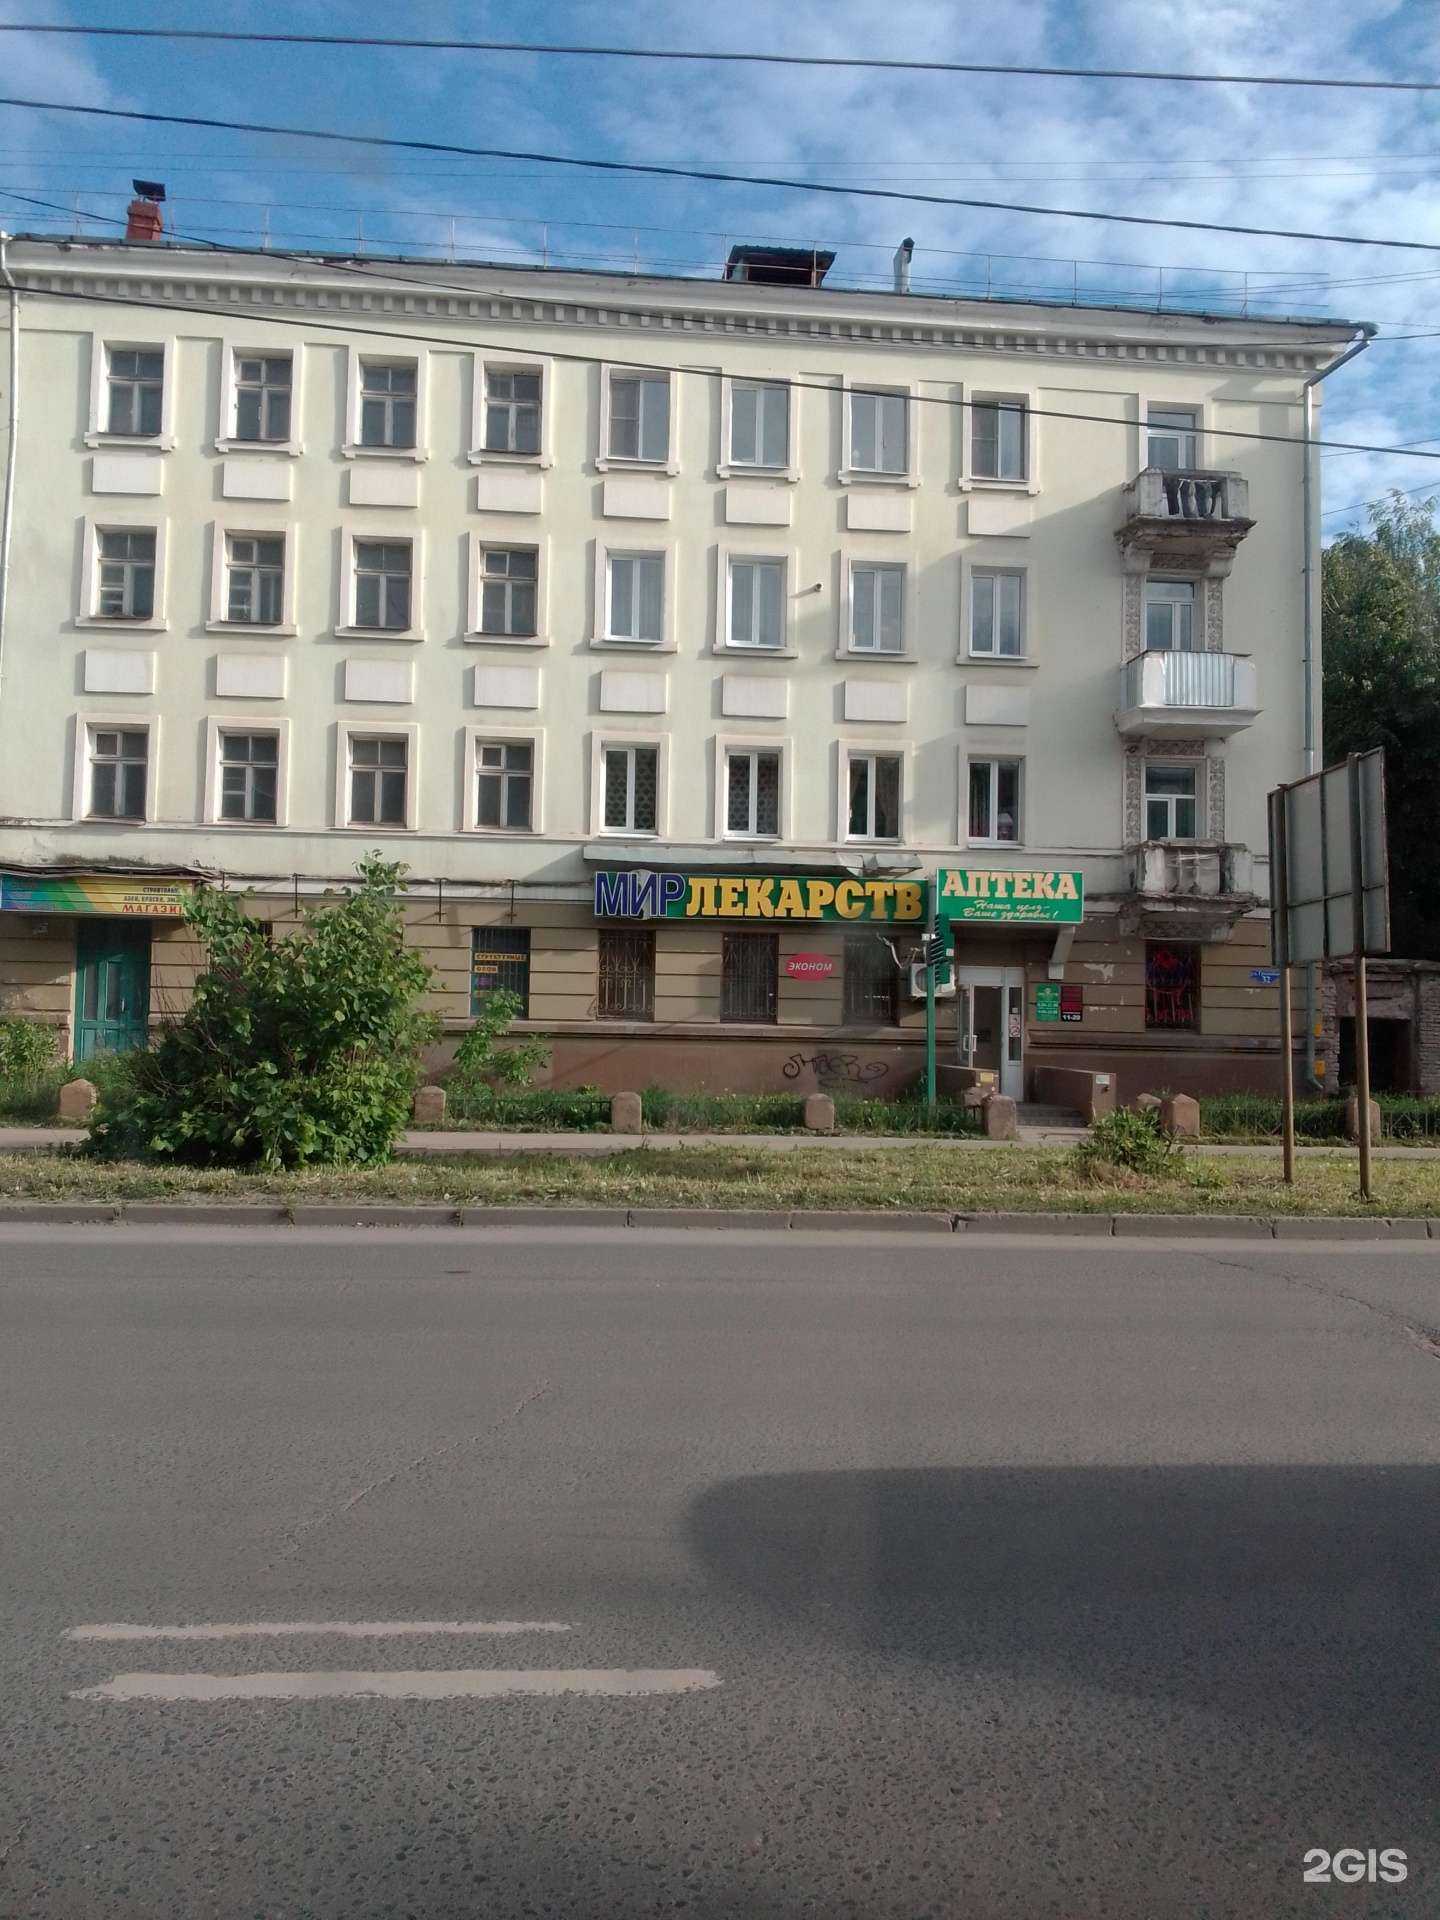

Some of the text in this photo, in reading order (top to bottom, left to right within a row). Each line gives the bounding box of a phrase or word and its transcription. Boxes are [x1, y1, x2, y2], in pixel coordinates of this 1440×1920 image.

[941, 870, 1079, 900] АПТЕКА
[594, 871, 922, 920] МИР ЛЕКАРСТВ
[974, 899, 1011, 910] Наша
[962, 907, 998, 918] Ваше
[788, 961, 833, 972] ЭКОНОМ
